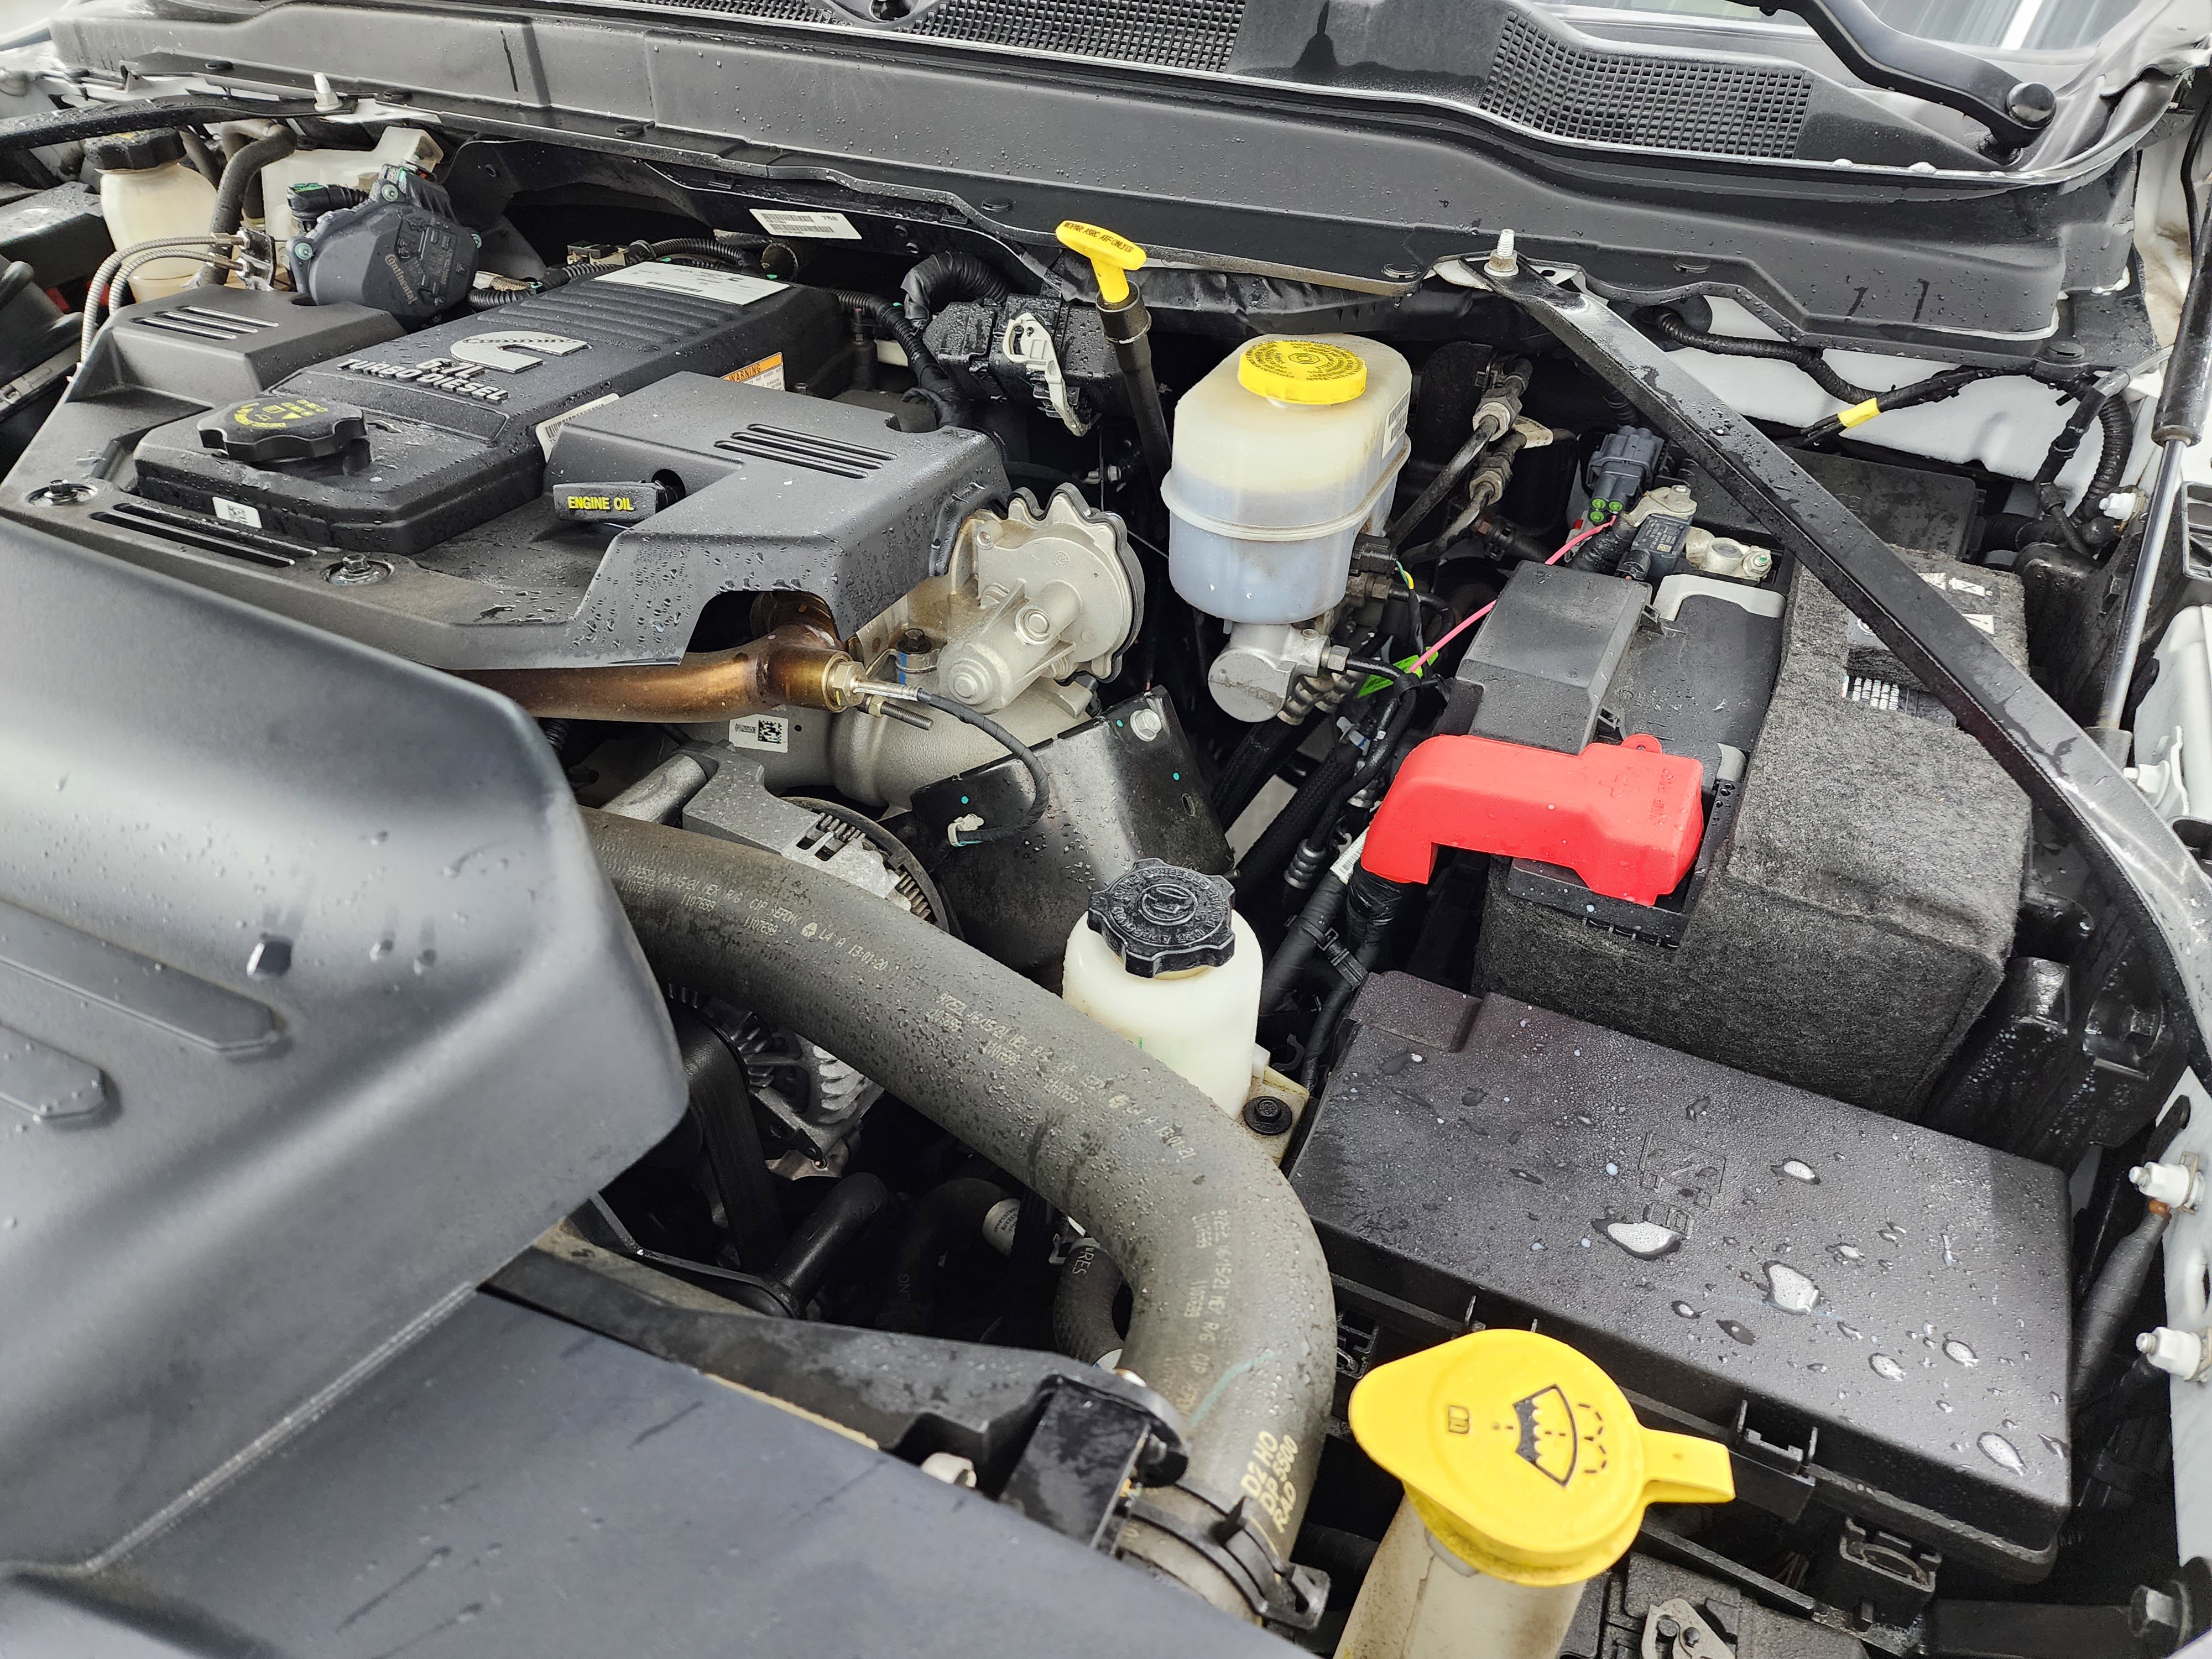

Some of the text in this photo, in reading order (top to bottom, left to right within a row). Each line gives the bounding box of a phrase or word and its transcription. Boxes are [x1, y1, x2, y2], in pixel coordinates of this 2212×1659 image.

[1063, 222, 1084, 232] MOPAR
[1099, 234, 1114, 243] ATF
[1111, 239, 1128, 251] ONLY
[385, 253, 418, 305] Continental
[336, 358, 508, 405] TURBO DIESEL
[729, 363, 761, 383] WARNING
[567, 496, 635, 511] ENGINE OIL
[681, 892, 717, 912] 1107699
[848, 944, 889, 971] 13:01:20
[1240, 1430, 1279, 1500] D2 HO
[1259, 1433, 1299, 1516] DP 5500
[1272, 1480, 1297, 1533] RAD
